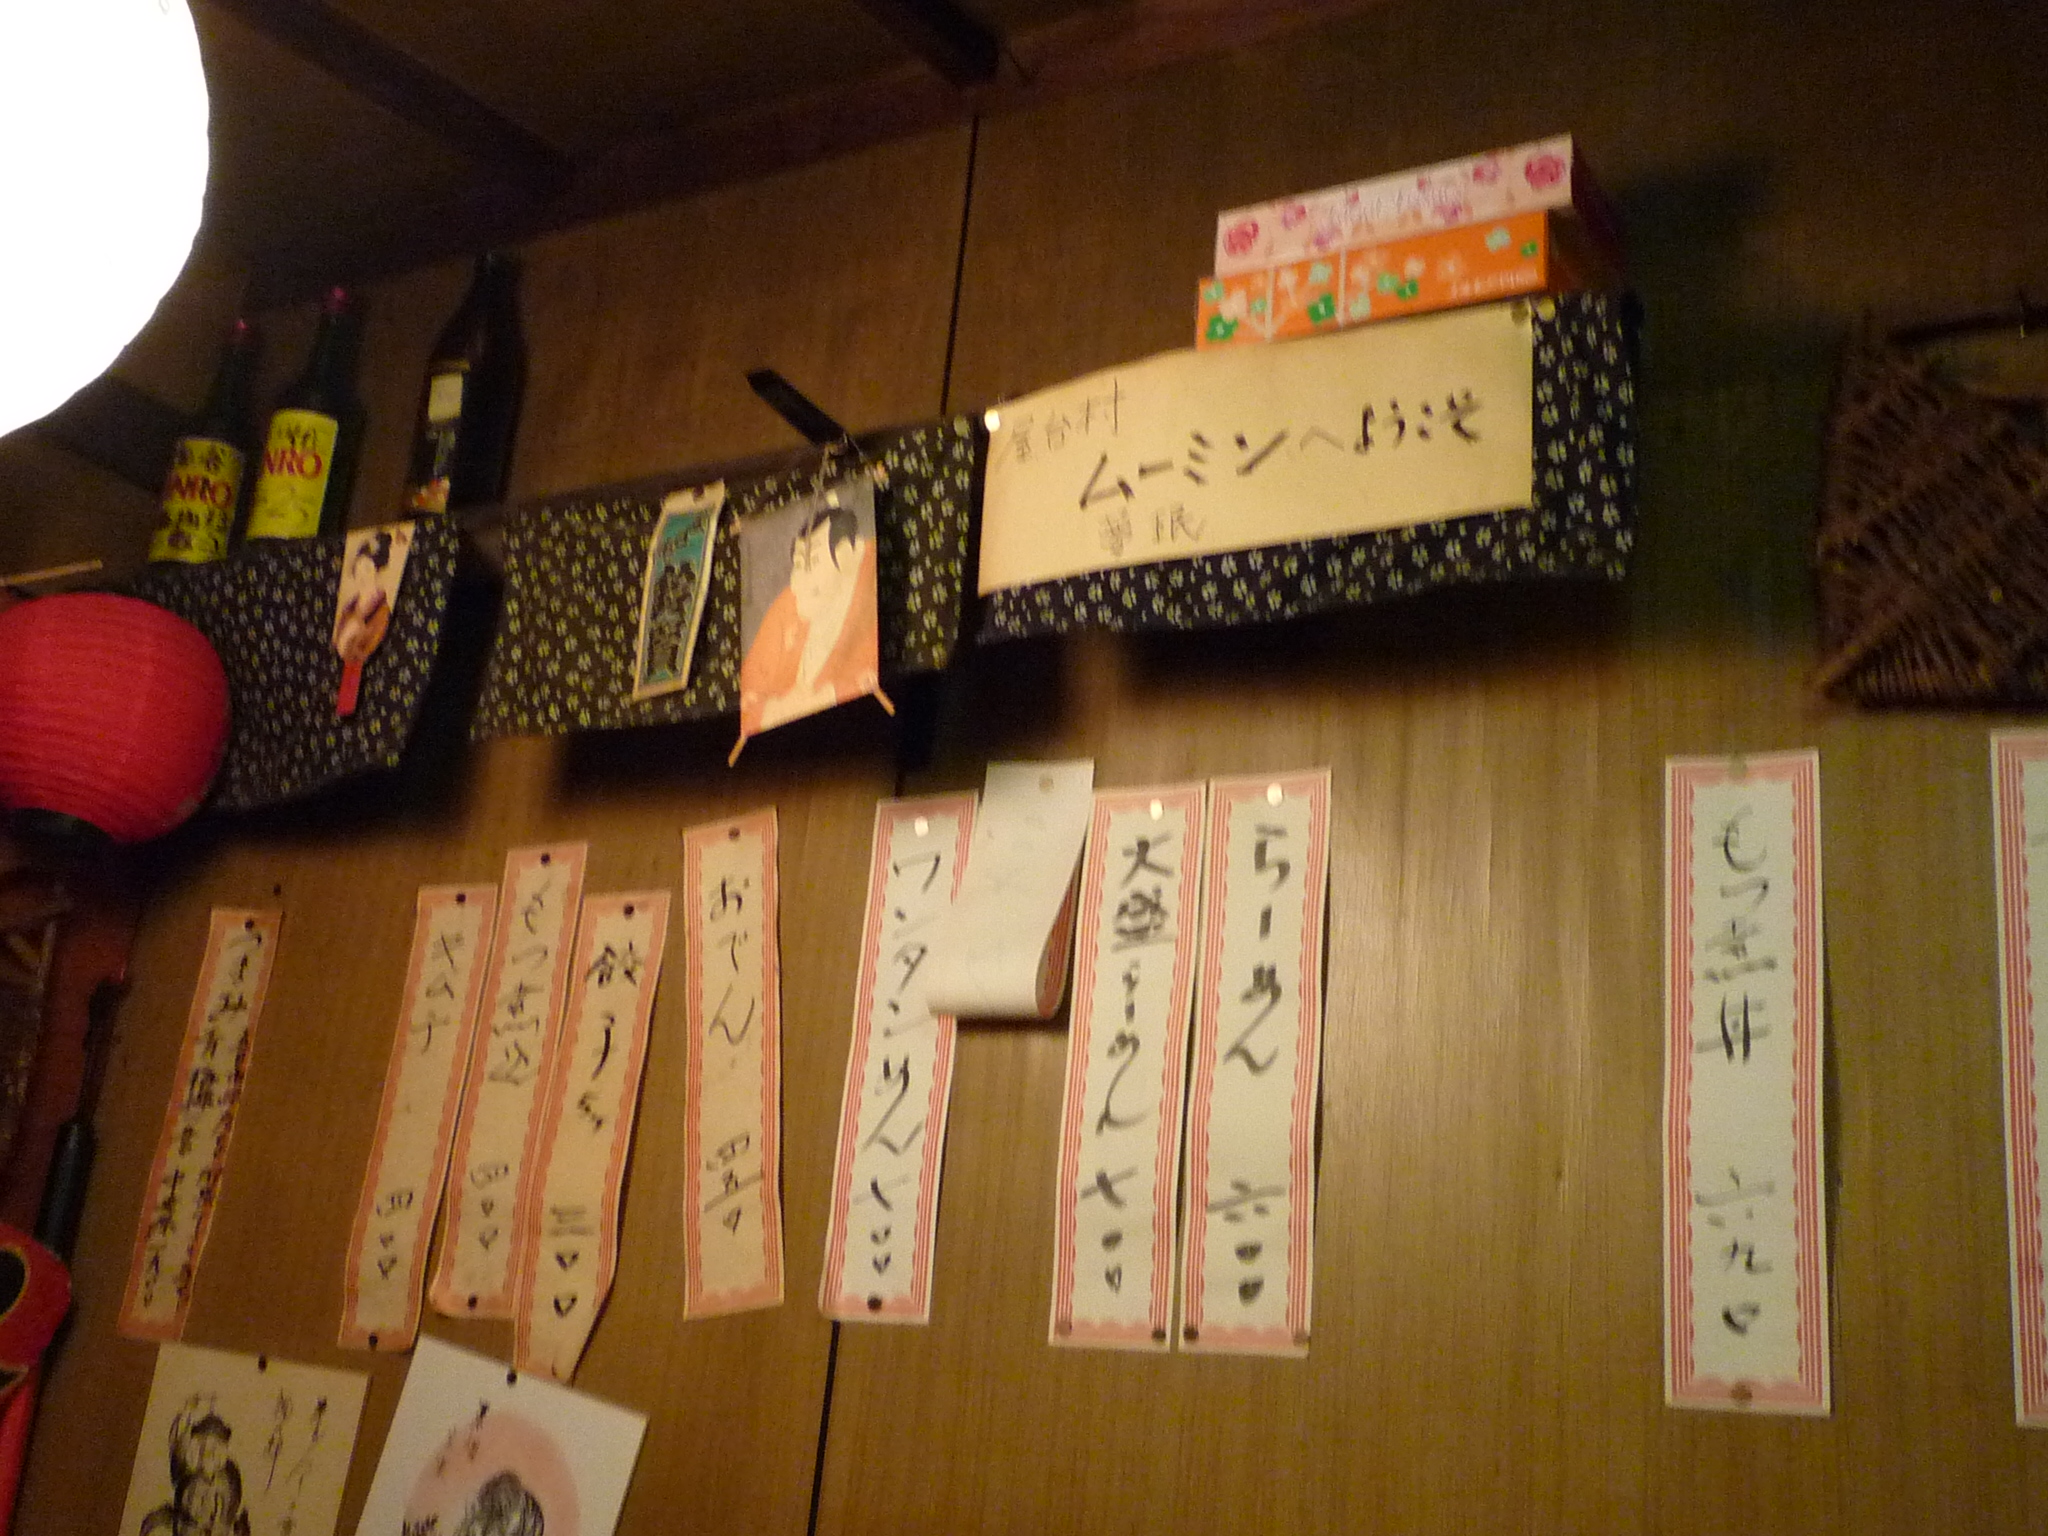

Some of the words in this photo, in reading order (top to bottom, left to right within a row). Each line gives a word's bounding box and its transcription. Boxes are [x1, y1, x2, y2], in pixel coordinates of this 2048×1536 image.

[1078, 385, 1482, 511] ムーミンへようこそ
